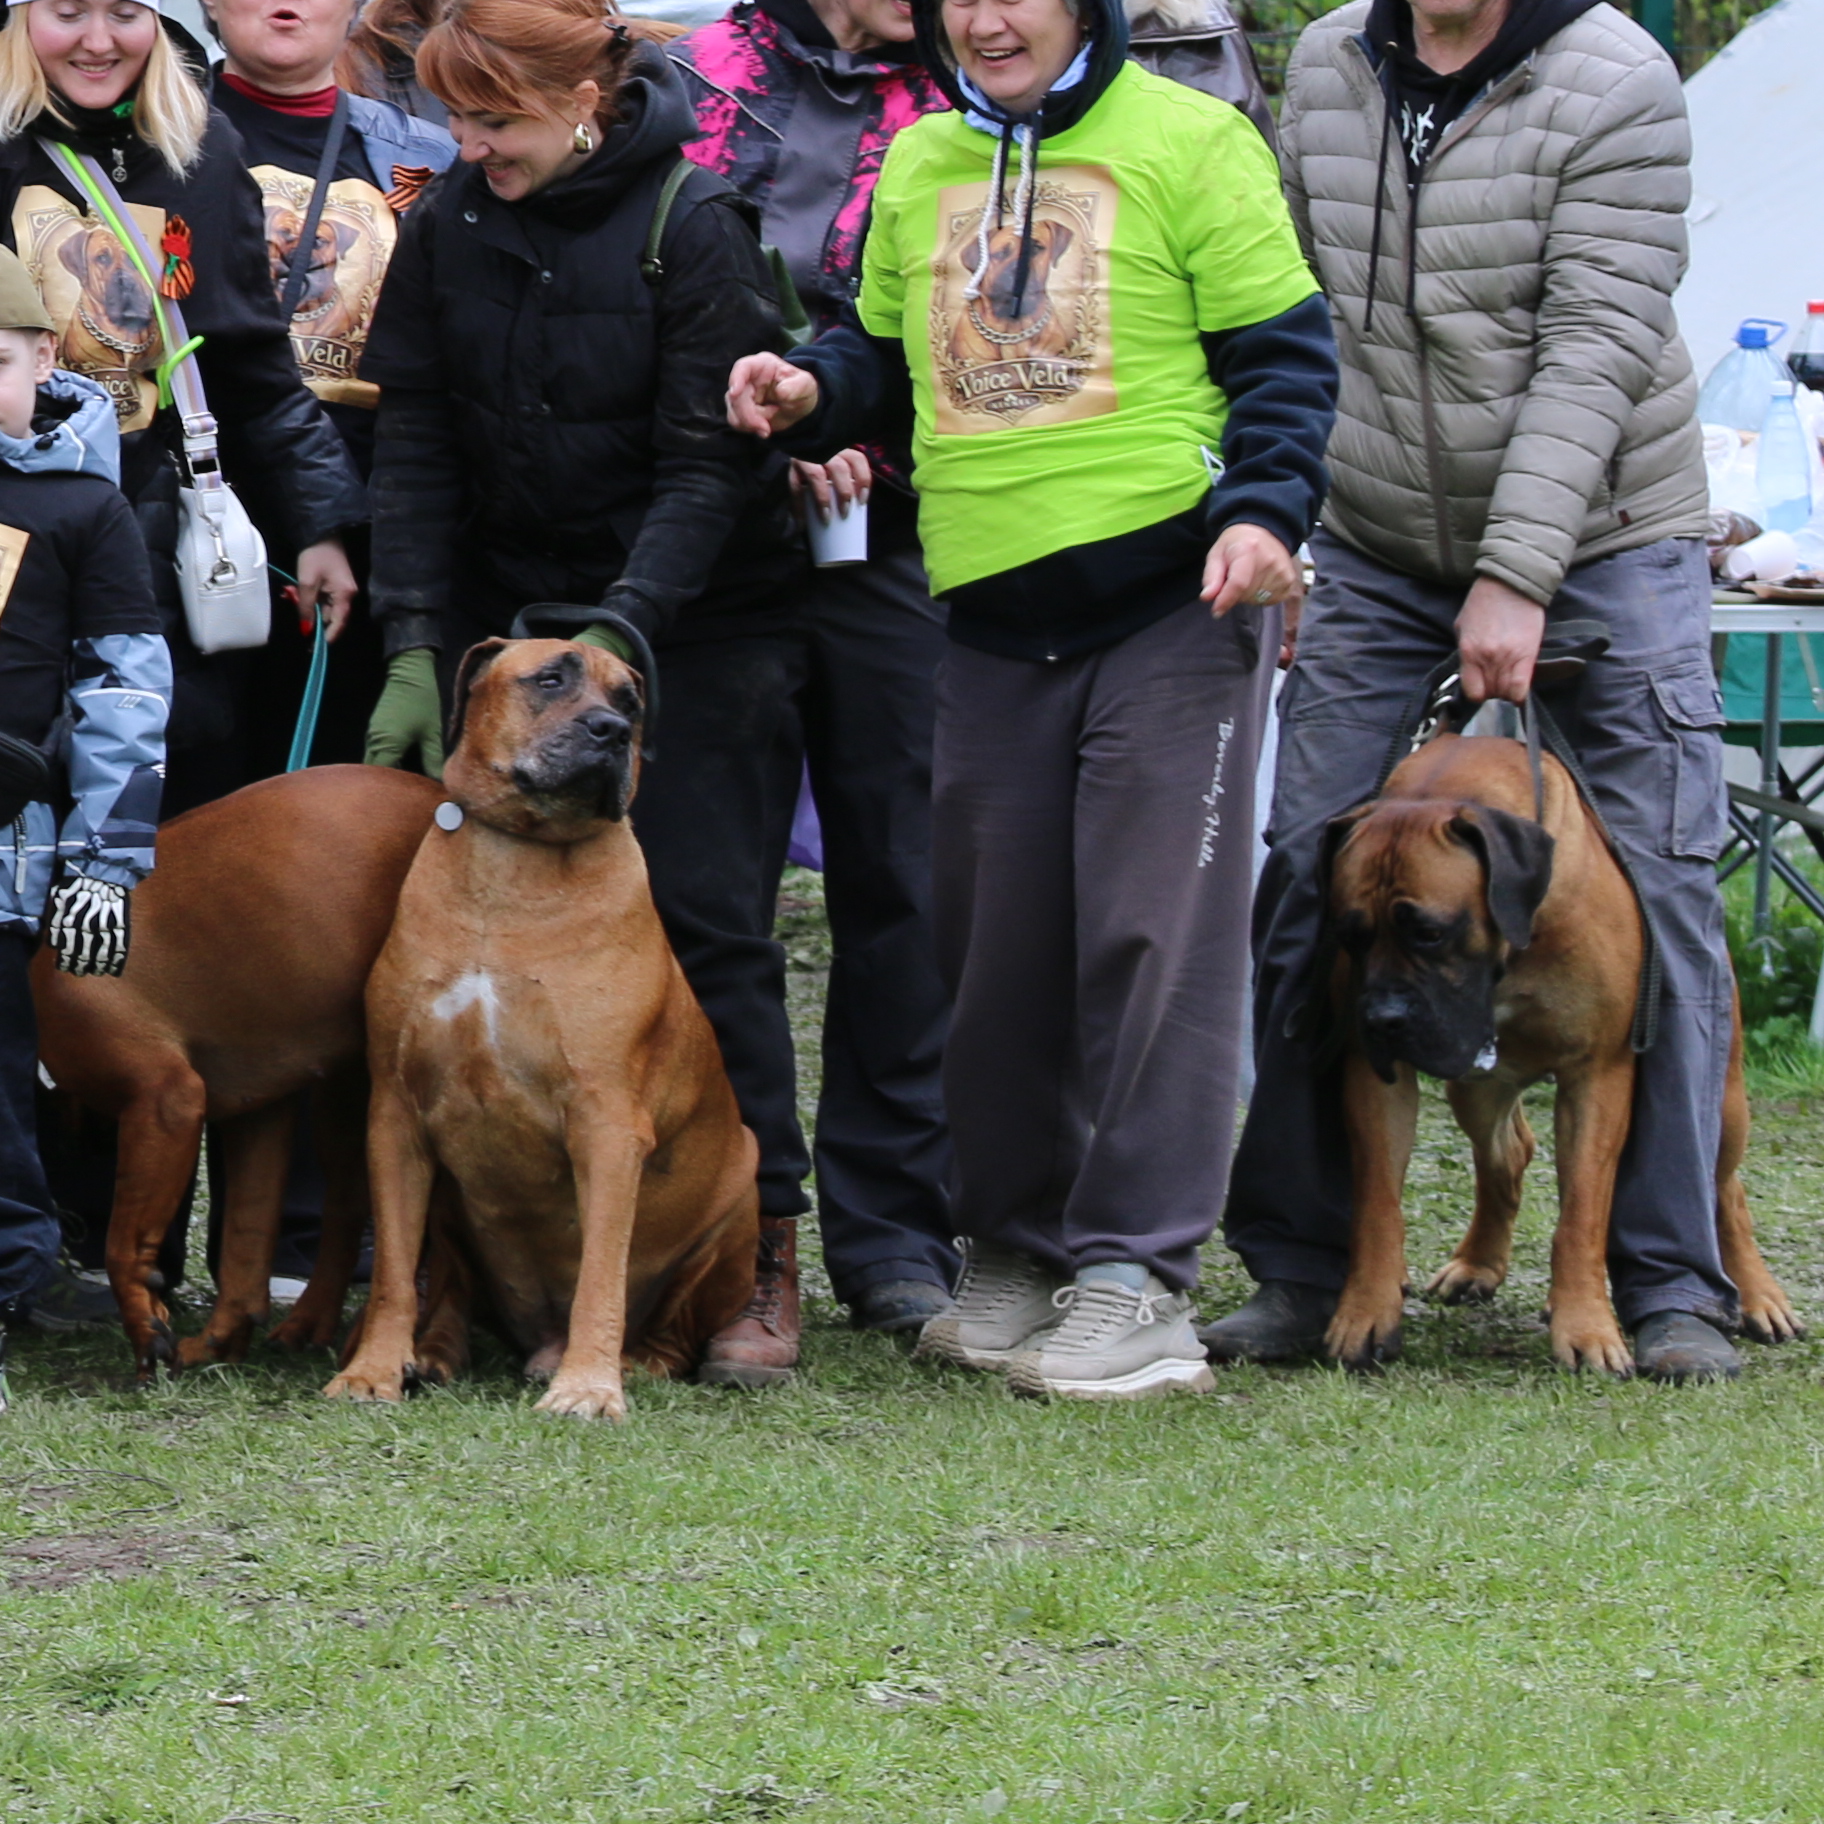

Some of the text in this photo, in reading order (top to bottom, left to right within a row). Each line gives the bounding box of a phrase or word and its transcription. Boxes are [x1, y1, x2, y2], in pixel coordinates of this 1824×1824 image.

[290, 337, 347, 369] Veld
[956, 362, 1070, 398] Voice Veld
